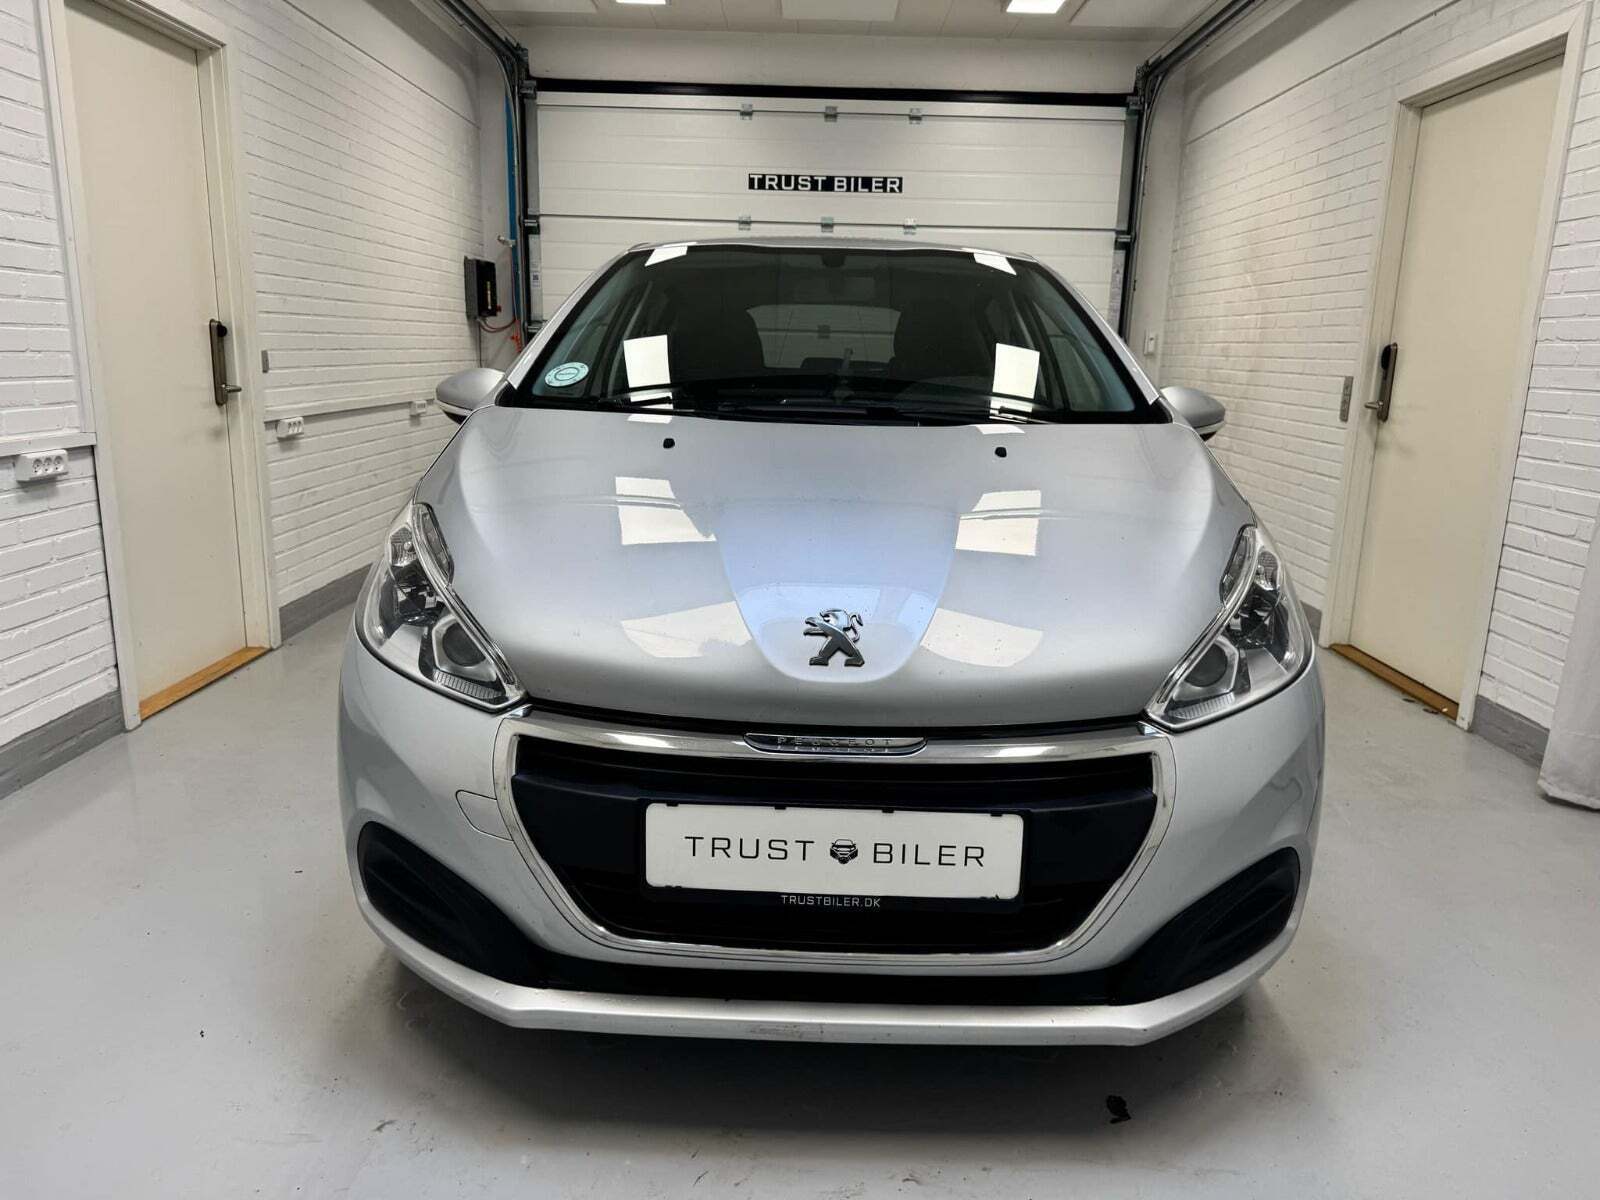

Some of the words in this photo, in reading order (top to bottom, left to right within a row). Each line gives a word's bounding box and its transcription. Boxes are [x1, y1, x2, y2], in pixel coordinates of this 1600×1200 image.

[750, 174, 827, 192] TRUST
[834, 176, 900, 193] BILER
[684, 835, 815, 862] TRUST
[873, 842, 985, 868] BILER
[780, 894, 881, 908] TRUSTBILER.DK
